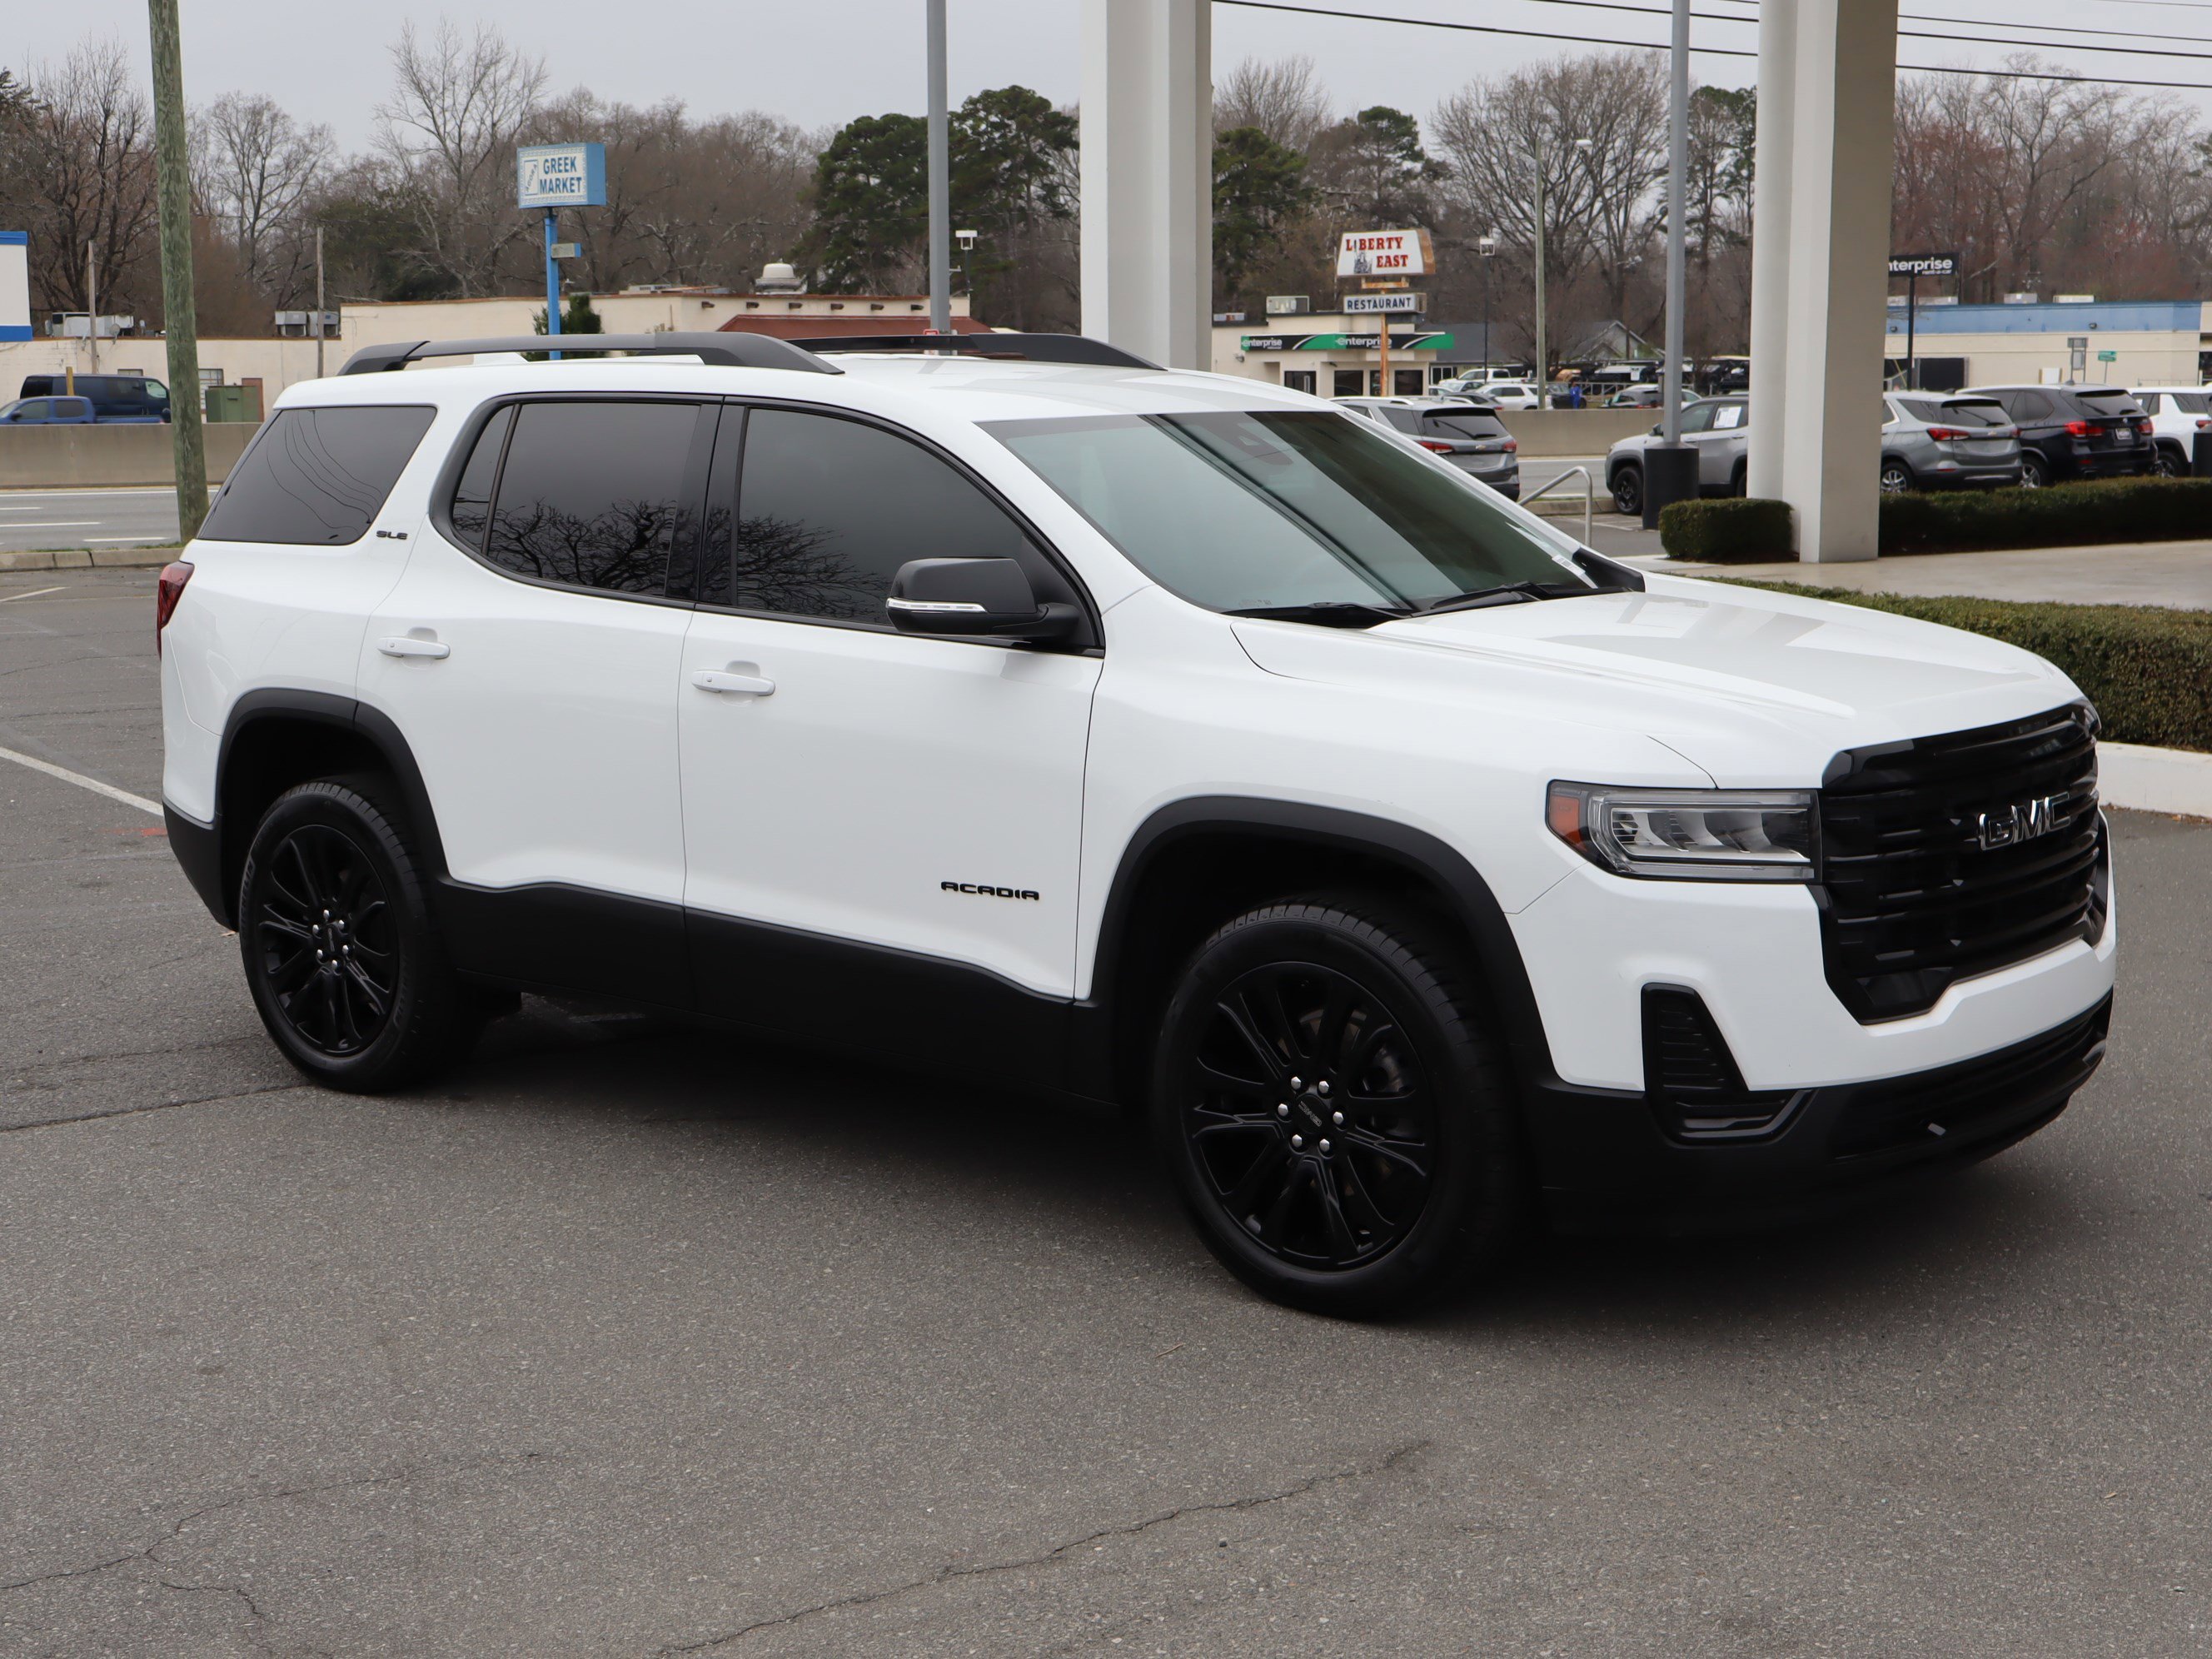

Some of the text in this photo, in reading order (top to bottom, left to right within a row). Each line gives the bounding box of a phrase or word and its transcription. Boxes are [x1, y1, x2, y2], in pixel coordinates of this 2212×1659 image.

[543, 156, 578, 175] GREEK
[540, 177, 582, 195] MARKET
[1346, 237, 1403, 252] LIBERTY
[1376, 255, 1409, 268] EAST
[1888, 257, 1953, 274] nterprise
[1347, 297, 1412, 311] RESTAURANT
[1241, 337, 1283, 348] enterprise
[1335, 336, 1392, 347] enterprie
[376, 531, 408, 540] SLE
[1979, 790, 2071, 850] GMC
[940, 881, 1039, 900] ACADIA
